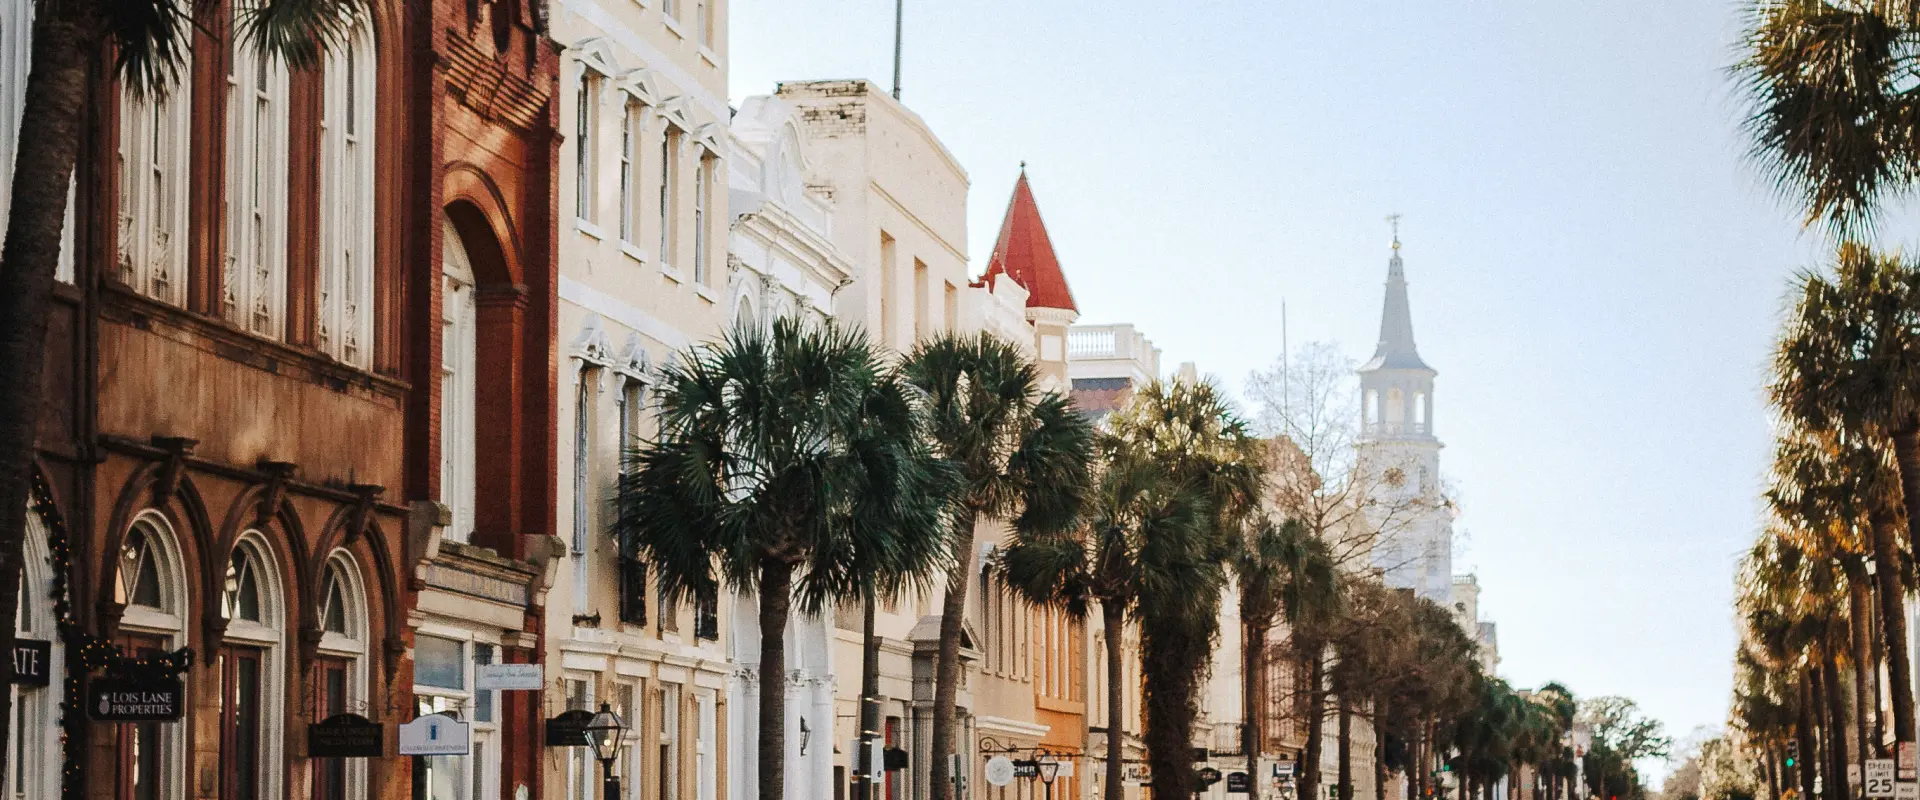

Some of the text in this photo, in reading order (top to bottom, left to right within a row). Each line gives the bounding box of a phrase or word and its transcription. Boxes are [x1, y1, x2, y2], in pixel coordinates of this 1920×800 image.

[112, 692, 172, 703] LOIS LANE
[112, 704, 172, 715] PROPERTIES
[1868, 779, 1893, 793] 25
